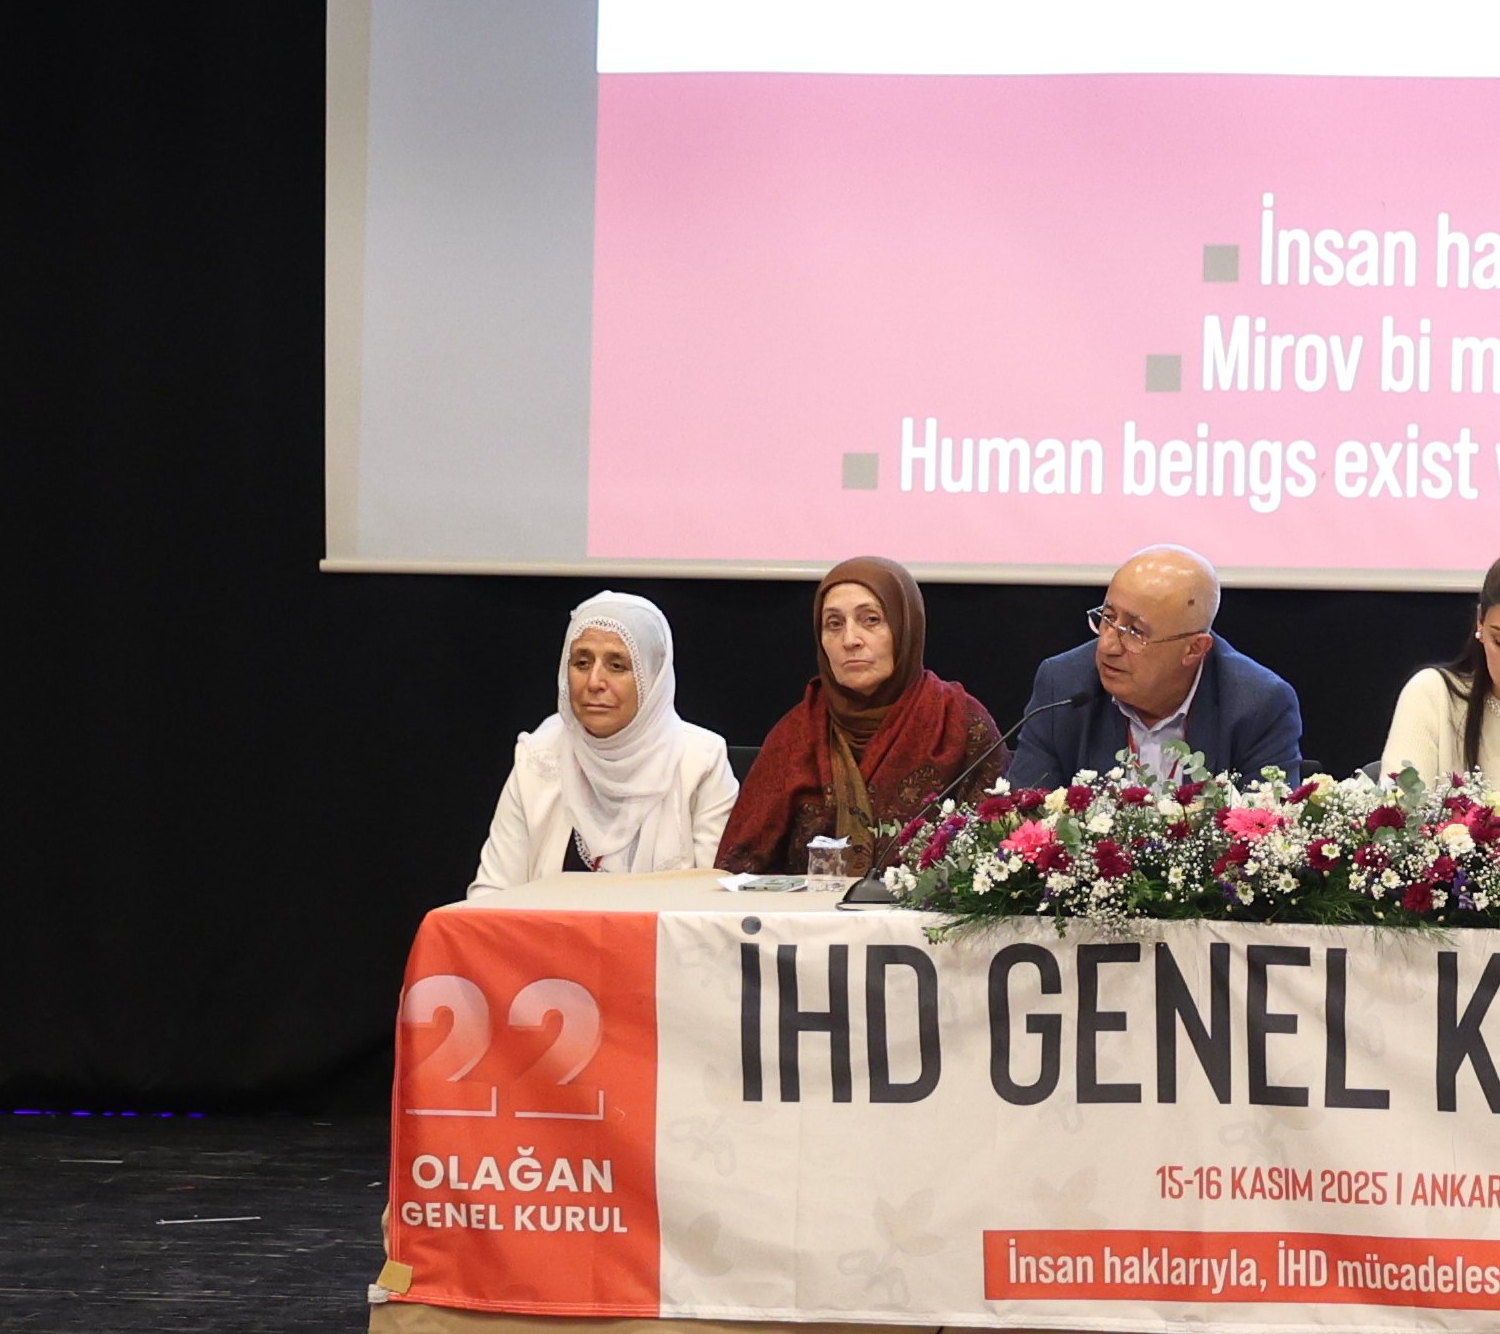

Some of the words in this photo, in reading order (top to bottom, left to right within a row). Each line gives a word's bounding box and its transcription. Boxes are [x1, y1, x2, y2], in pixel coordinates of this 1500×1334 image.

[1260, 193, 1417, 288] İnsan
[1202, 315, 1364, 393] Mirov
[1380, 316, 1432, 393] bi
[900, 416, 1104, 495] Human
[1122, 420, 1317, 514] beings
[1334, 423, 1480, 500] exist
[740, 916, 941, 1104] İHD
[988, 941, 1391, 1111] GENEL
[411, 1145, 614, 1194] OLAĞAN
[1156, 1165, 1224, 1200] 15-16
[1231, 1166, 1314, 1202] KASIM
[1321, 1169, 1388, 1205] 2025
[401, 1201, 504, 1231] GENEL
[514, 1204, 629, 1233] KURUL
[1008, 1237, 1094, 1285] İnsan
[1103, 1244, 1267, 1294] haklarıyla,
[1278, 1239, 1328, 1287] İHD
